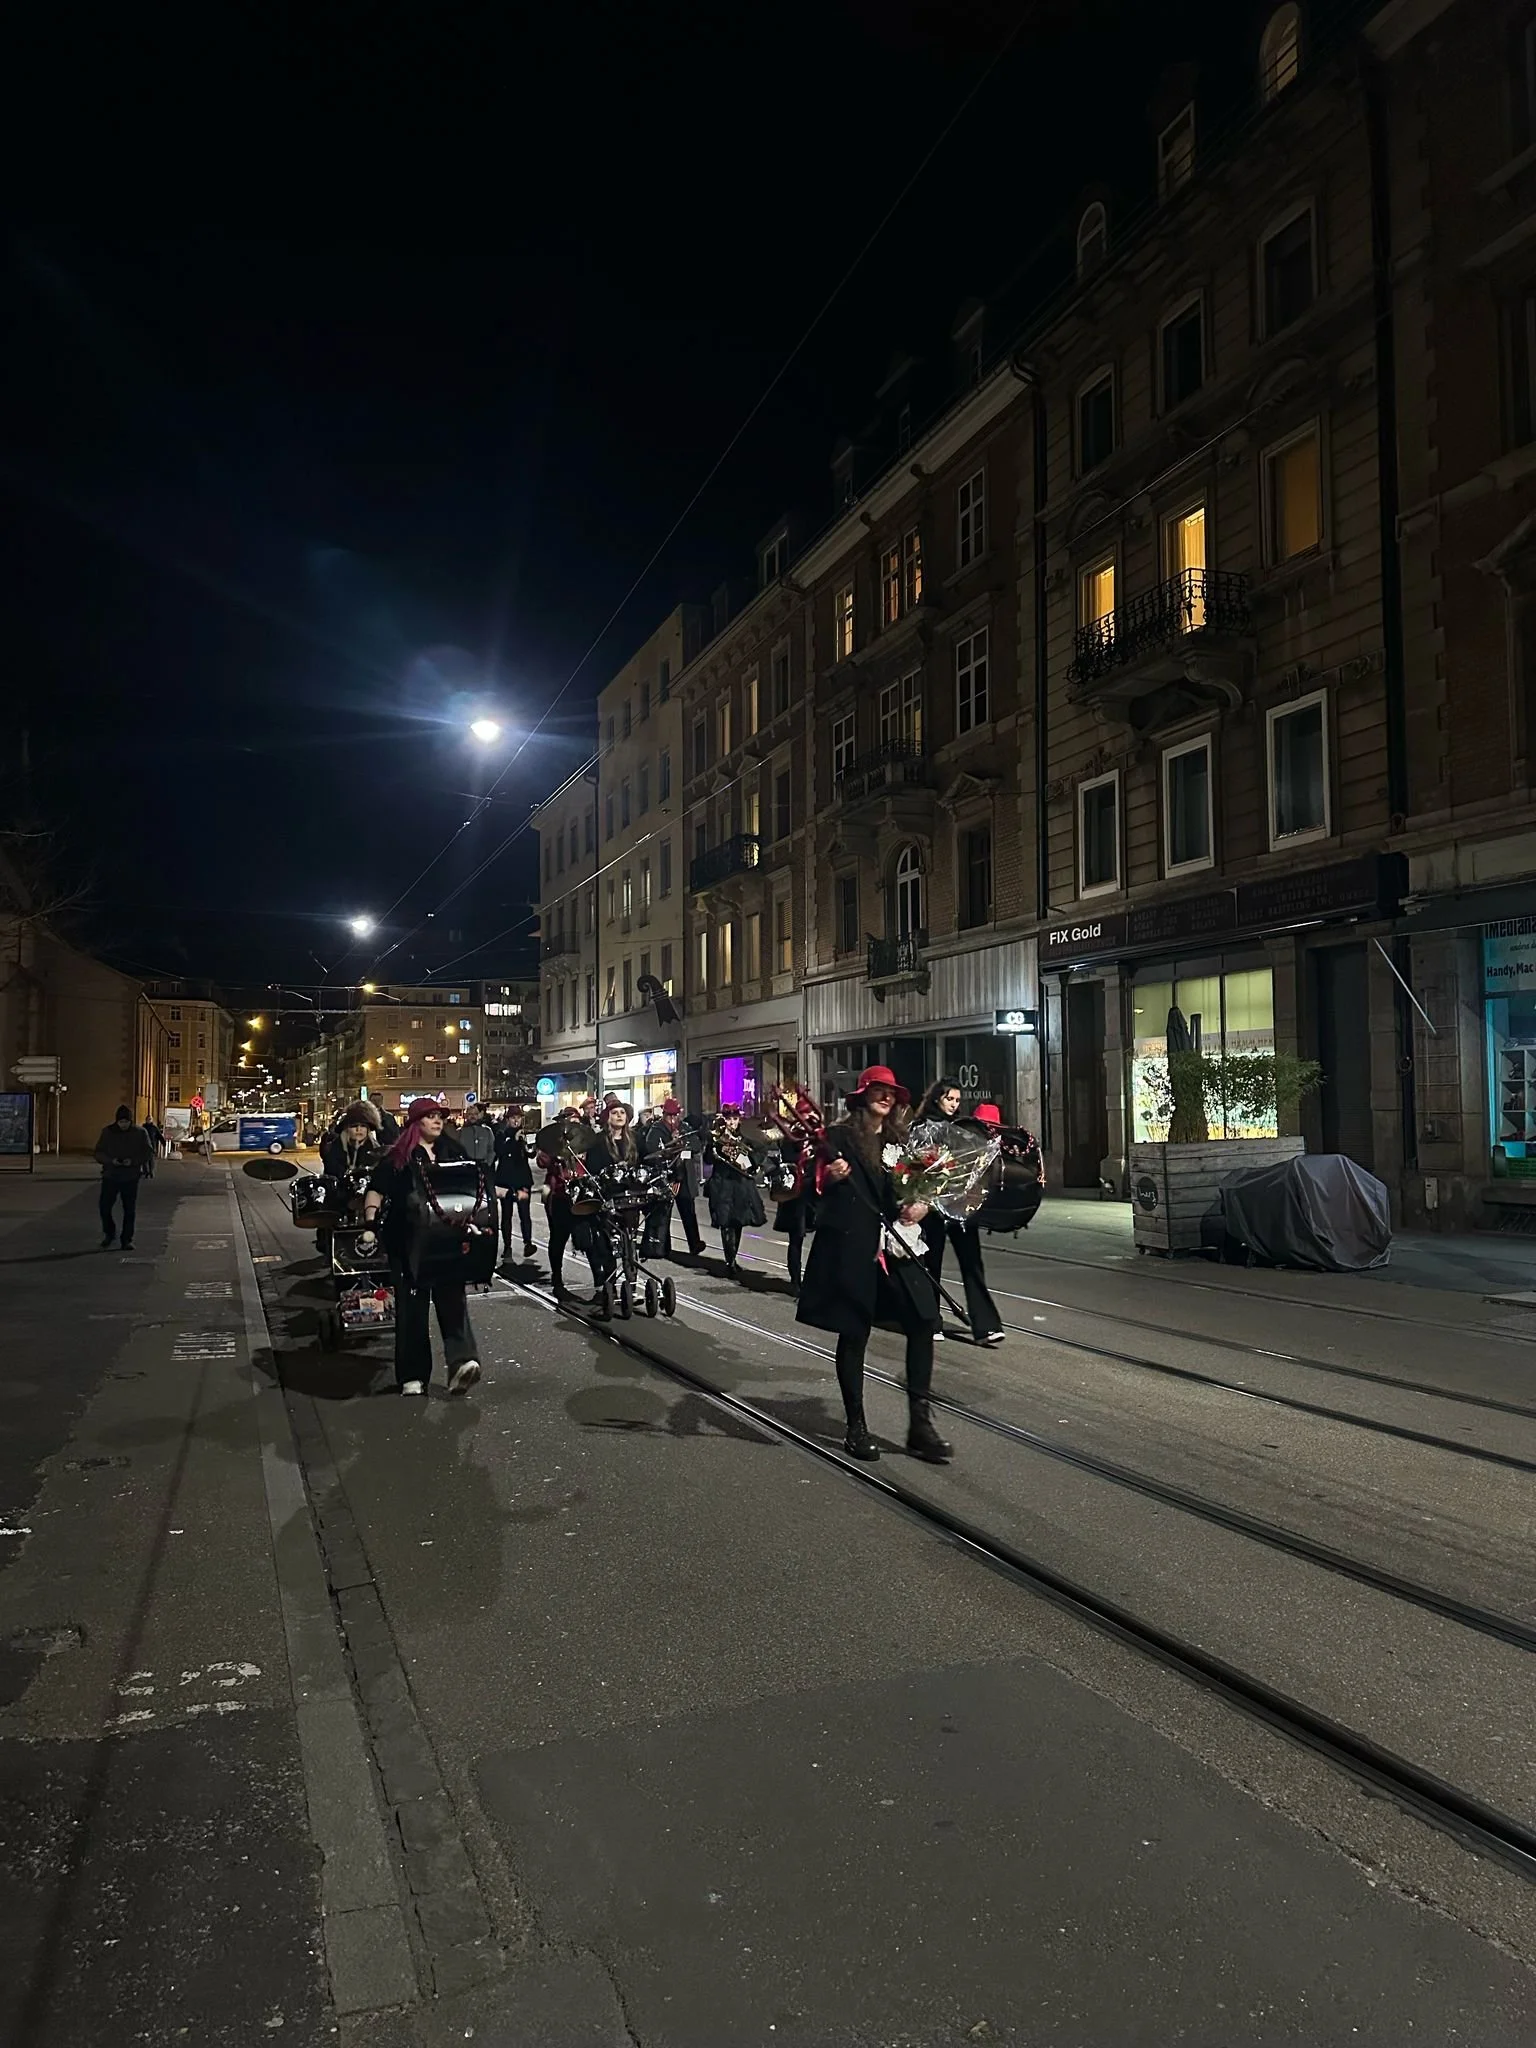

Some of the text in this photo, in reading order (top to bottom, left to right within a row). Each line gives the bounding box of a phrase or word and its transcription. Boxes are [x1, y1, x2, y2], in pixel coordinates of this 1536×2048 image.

[1050, 923, 1101, 945] FIX Gold
[1006, 1011, 1025, 1025] CG
[959, 1064, 979, 1088] CG
